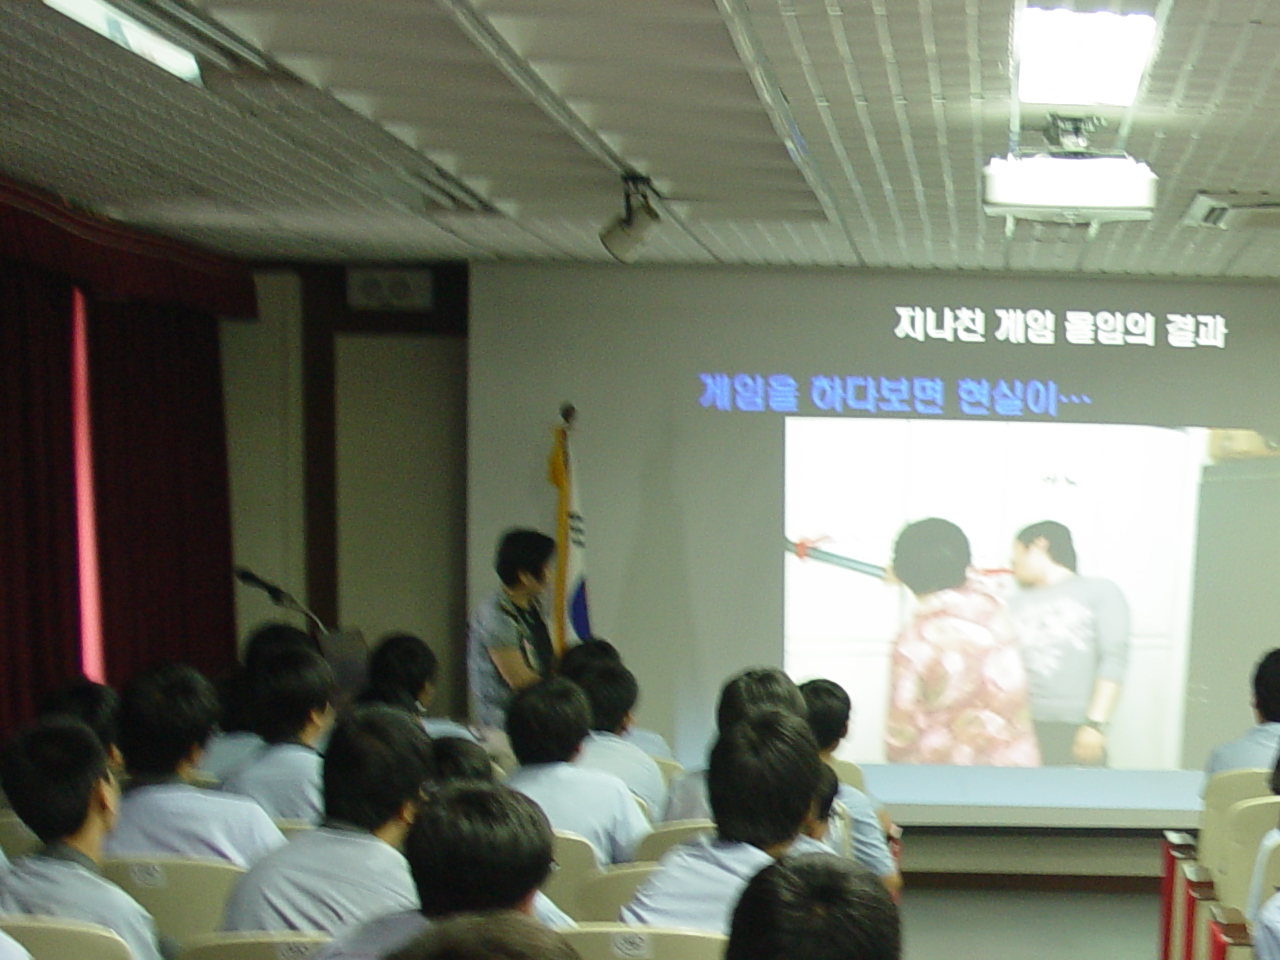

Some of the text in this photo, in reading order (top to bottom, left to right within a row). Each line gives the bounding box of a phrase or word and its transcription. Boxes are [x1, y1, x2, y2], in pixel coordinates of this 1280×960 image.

[894, 306, 1228, 349] 지나친 게임 몰입의 결과
[698, 372, 799, 413] 게임을
[810, 374, 943, 415] 하다보면
